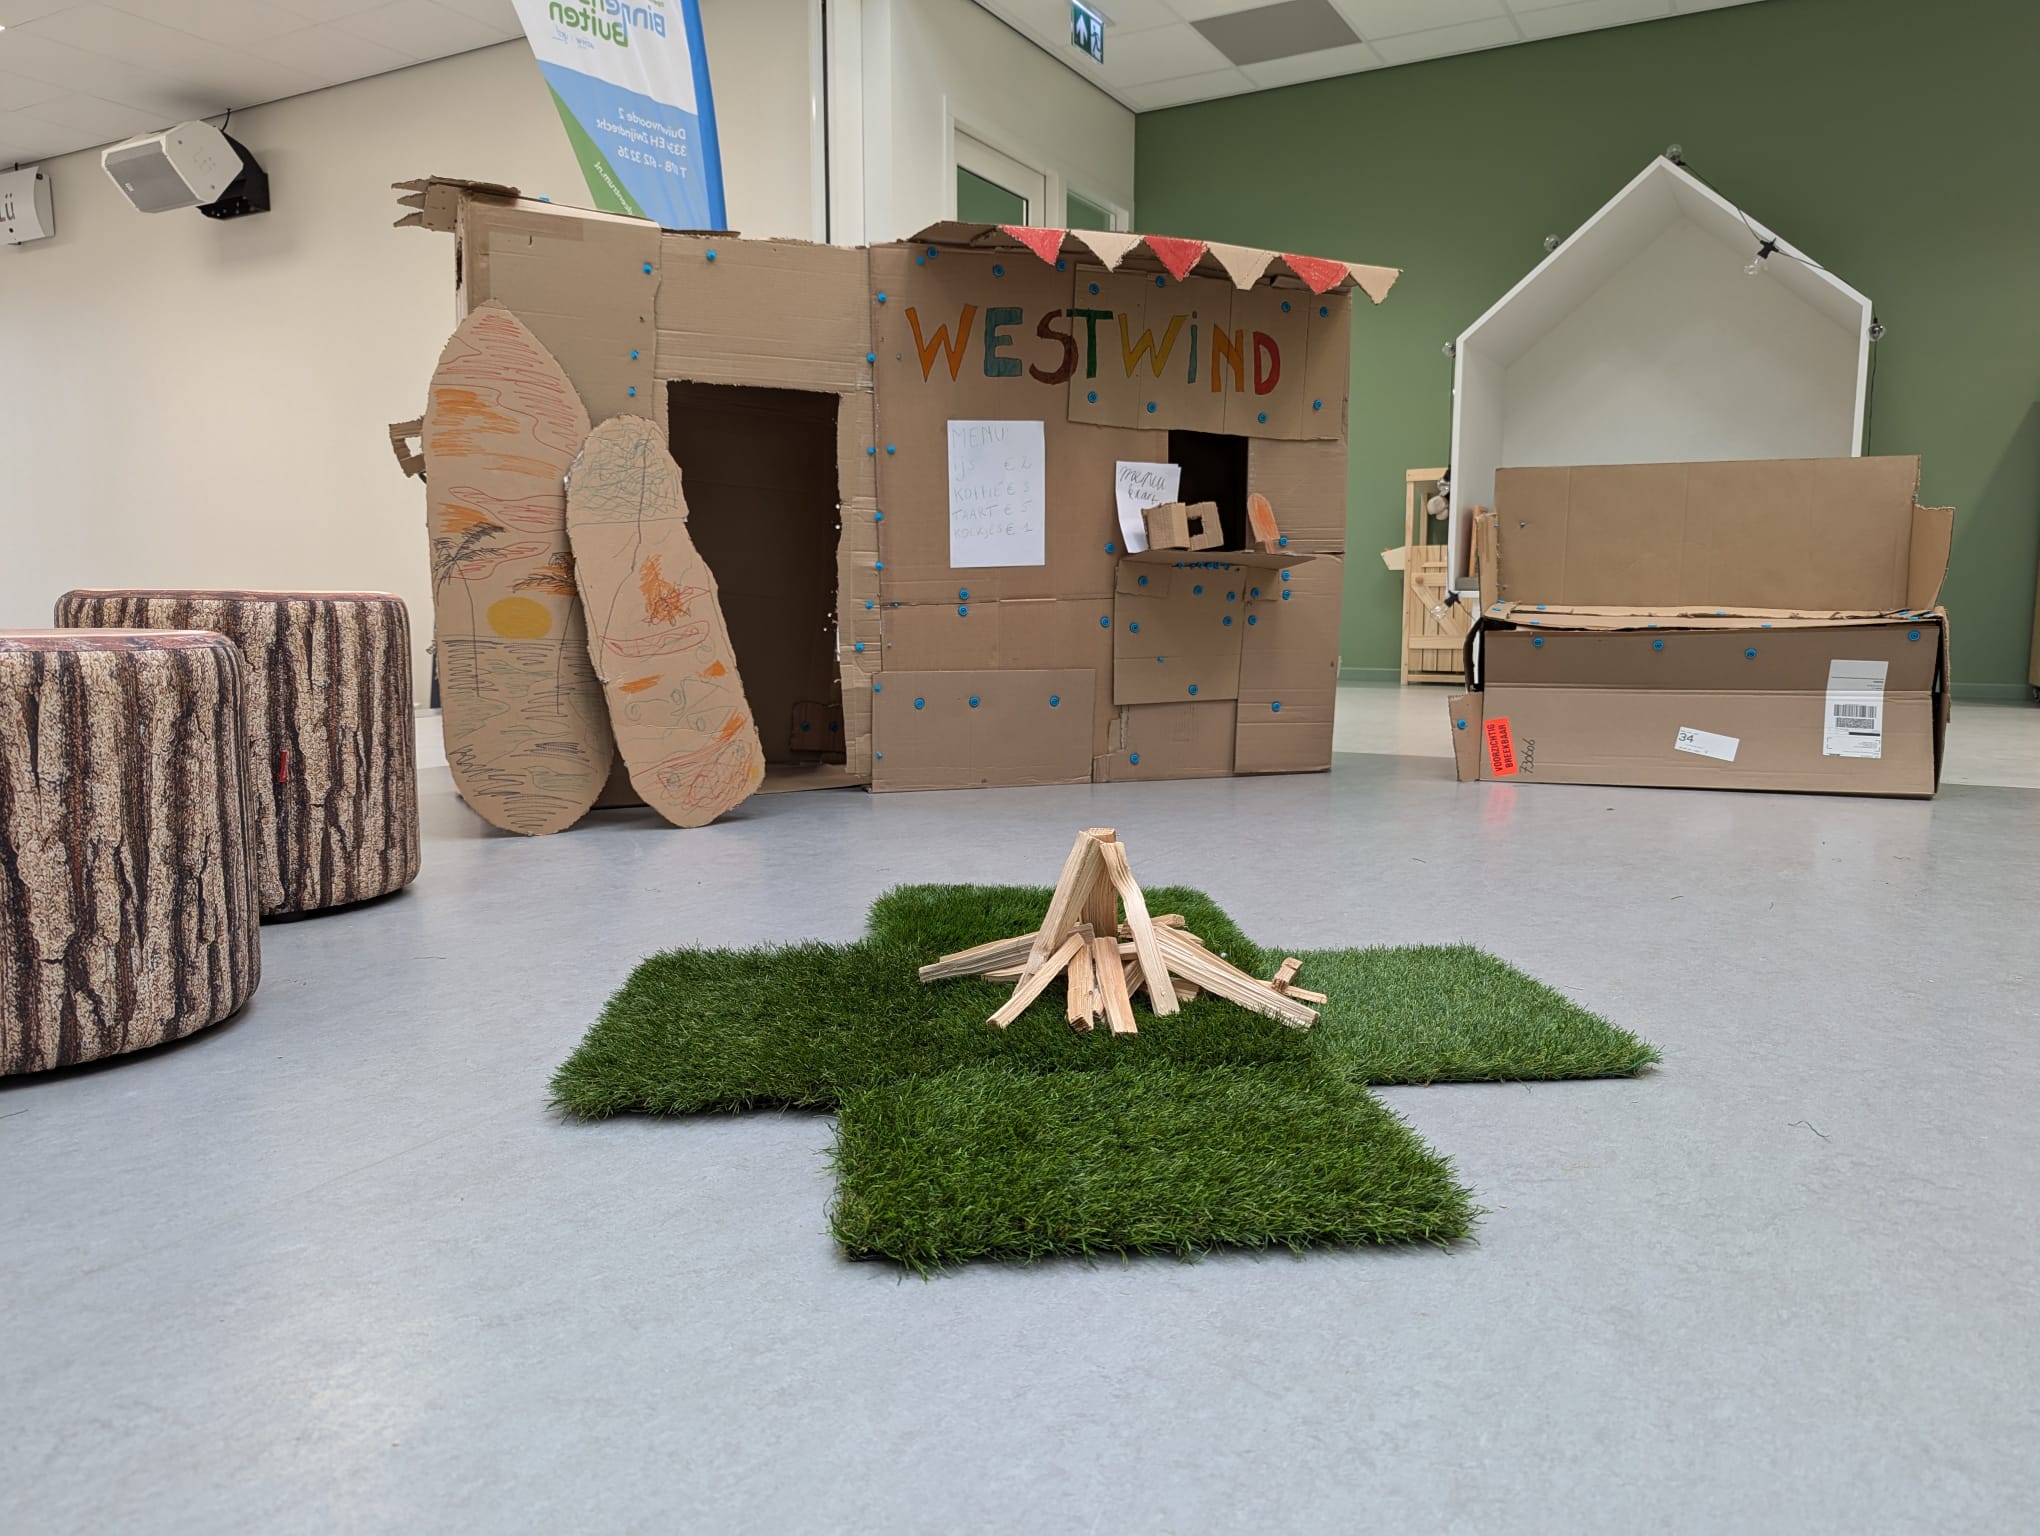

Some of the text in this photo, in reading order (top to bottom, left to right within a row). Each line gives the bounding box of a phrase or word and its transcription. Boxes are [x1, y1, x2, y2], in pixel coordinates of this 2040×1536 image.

[952, 425, 1005, 449] MENU
[1486, 723, 1503, 772] VOORZICHTIG
[1498, 723, 1514, 769] BREEKBAAR
[1678, 732, 1694, 744] 34
